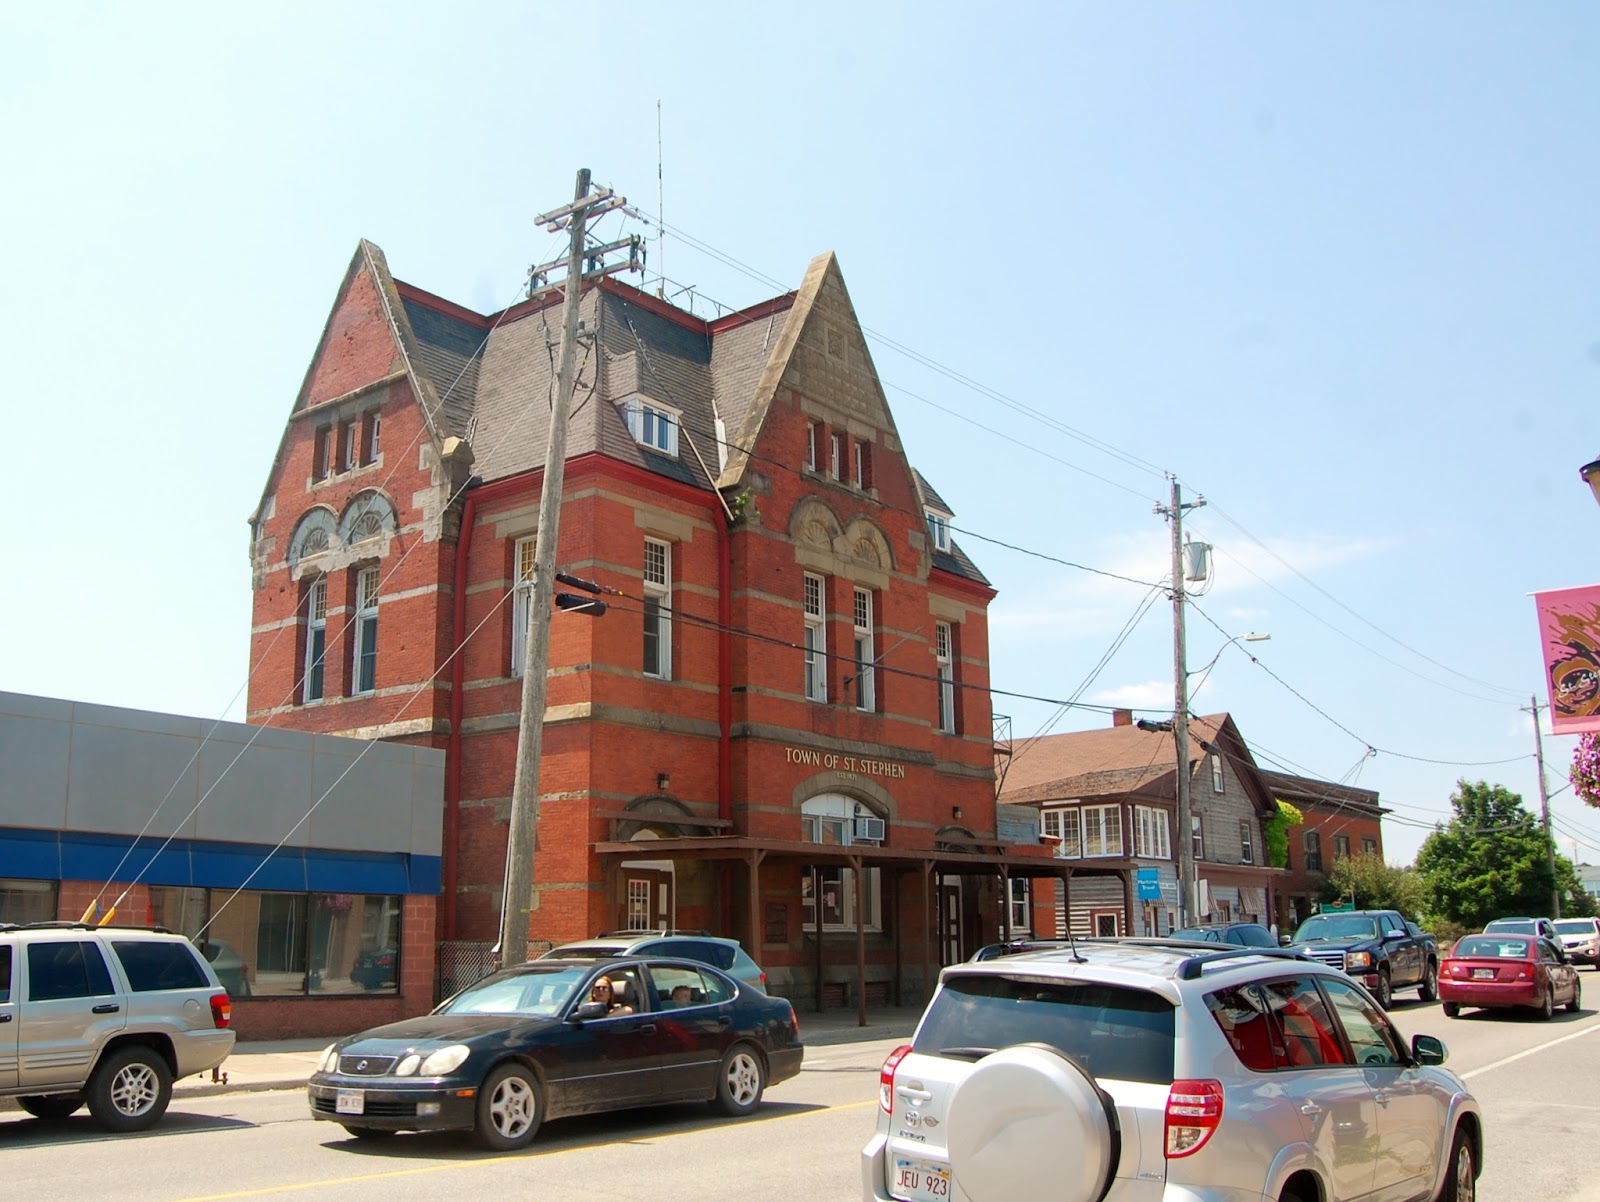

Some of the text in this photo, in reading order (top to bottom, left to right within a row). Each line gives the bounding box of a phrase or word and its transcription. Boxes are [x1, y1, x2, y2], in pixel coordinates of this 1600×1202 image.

[785, 747, 820, 766] TOWN
[824, 754, 839, 769] OF
[861, 759, 905, 778] STEPHEN
[897, 1170, 947, 1196] JEU 923
